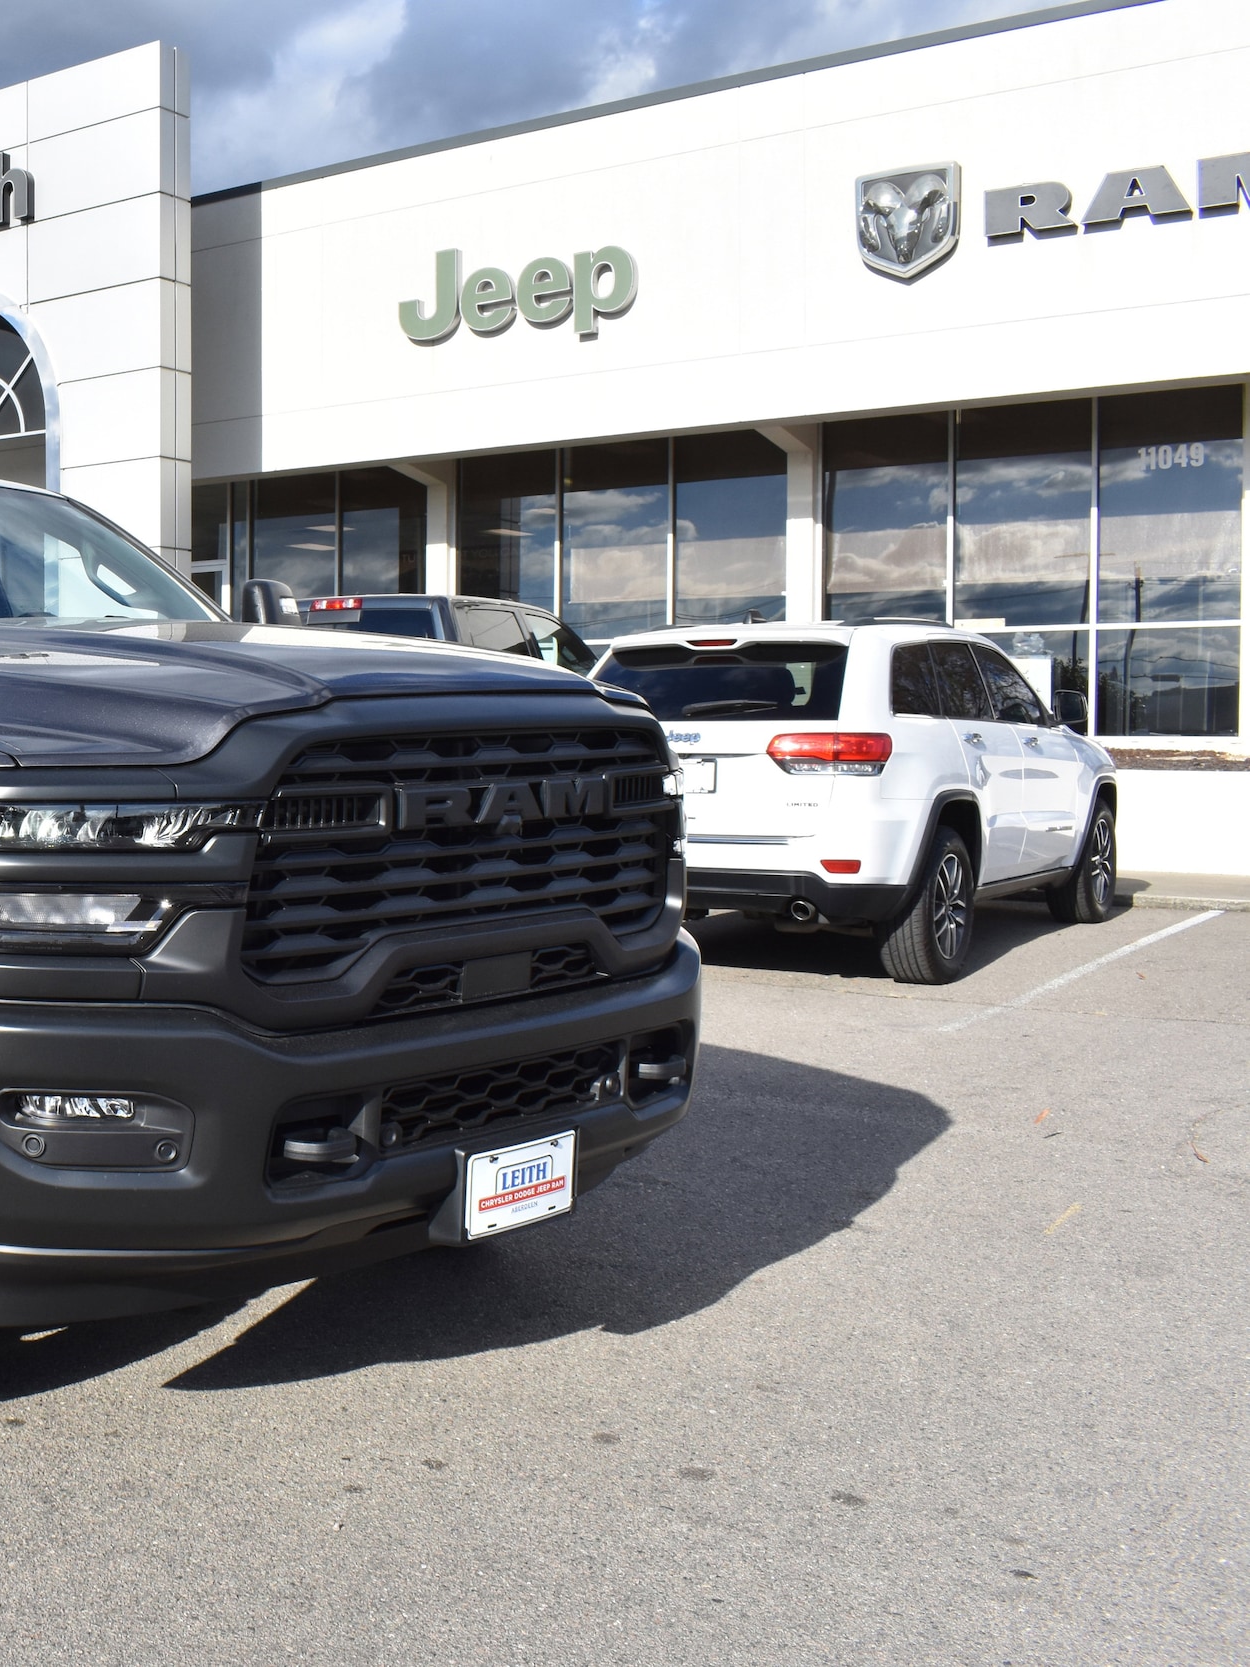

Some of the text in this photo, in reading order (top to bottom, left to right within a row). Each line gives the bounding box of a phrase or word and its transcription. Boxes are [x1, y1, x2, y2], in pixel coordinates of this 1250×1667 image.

[398, 245, 638, 346] Jeep
[1138, 442, 1205, 471] 11049
[398, 774, 604, 830] RAM
[501, 1161, 548, 1190] LEITH
[480, 1178, 564, 1208] CHRYSLER DODGE JEEP RAM
[510, 1200, 538, 1213] ABERDEEN
